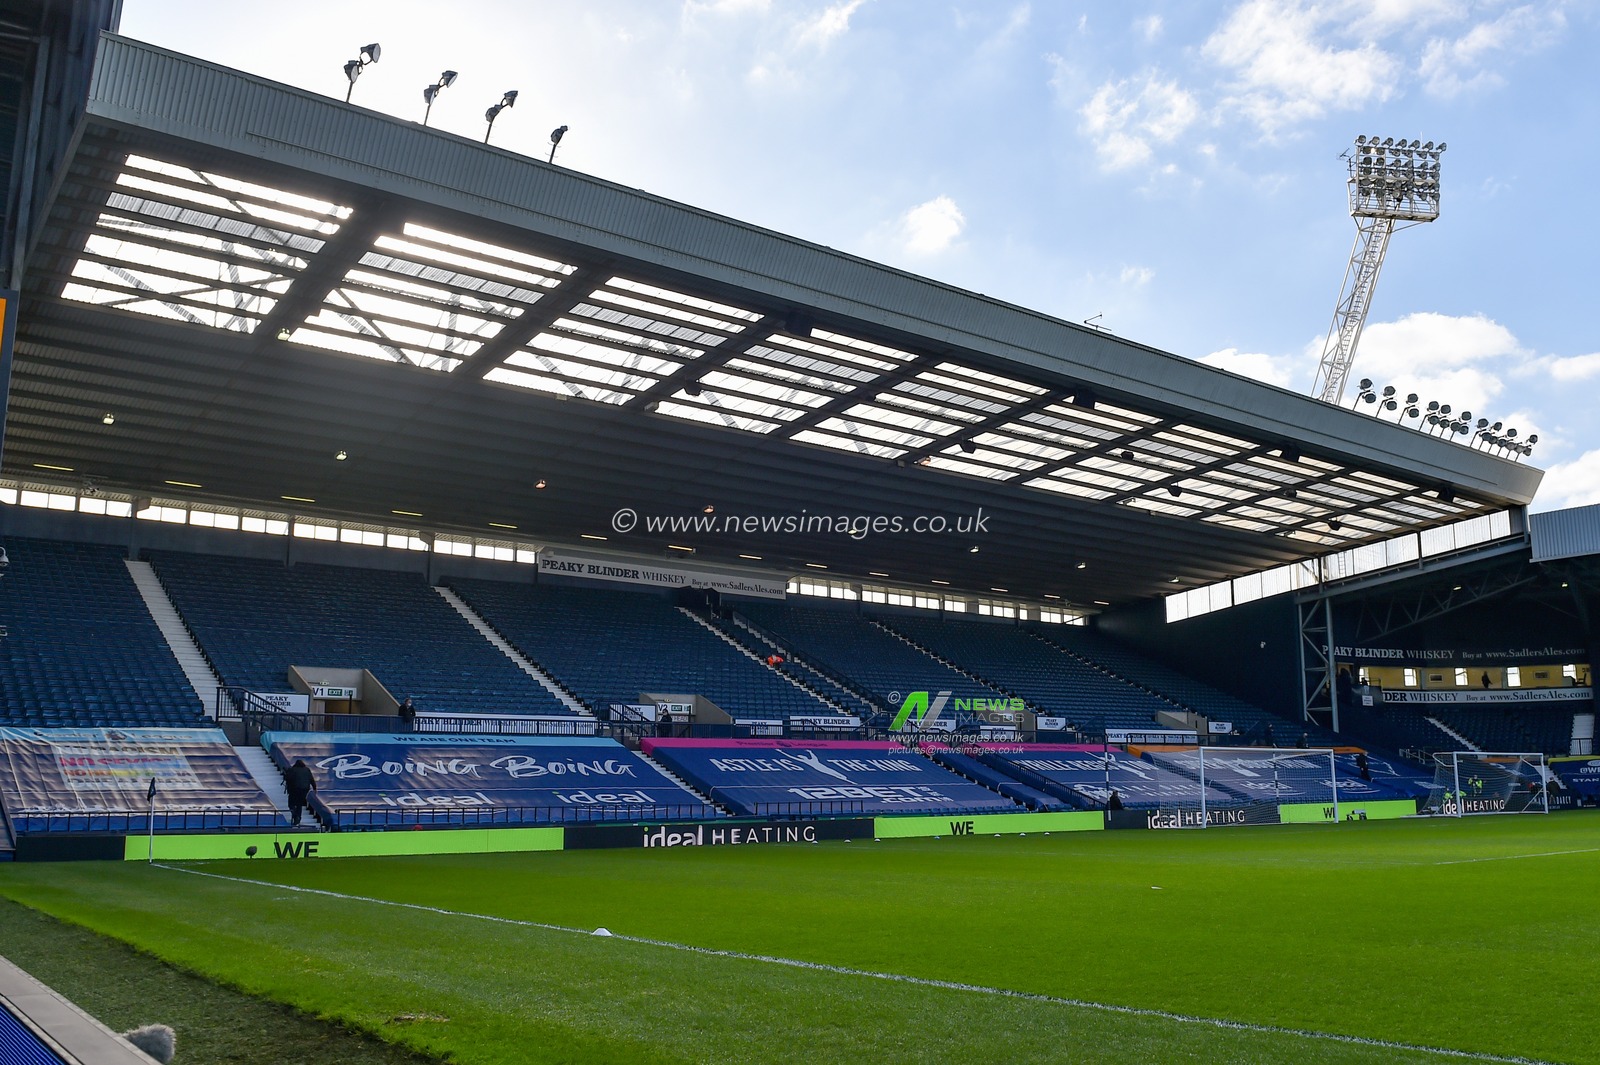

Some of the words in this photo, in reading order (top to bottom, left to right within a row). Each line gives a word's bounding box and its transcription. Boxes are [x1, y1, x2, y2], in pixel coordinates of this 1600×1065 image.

[541, 559, 585, 573] PEAKY
[587, 564, 640, 579] BLINDER
[642, 571, 687, 584] WHISKEY
[711, 580, 784, 596] www.SadlersAles.com
[1322, 644, 1353, 656] PAKY
[1354, 647, 1405, 659] BLINDER
[1406, 649, 1455, 659] WHISKEY
[1462, 651, 1474, 660] Buy
[1485, 647, 1585, 659] www.SadlersAles.com
[313, 687, 324, 696] V1
[1409, 692, 1459, 702] WHISKEY
[1466, 694, 1478, 702] Buy
[1489, 690, 1590, 701] www.SadlersAles.com
[59, 756, 95, 767] NO
[709, 758, 783, 772] ASTLE
[772, 759, 804, 772] IS
[827, 759, 878, 772] THE
[873, 759, 923, 772] KING
[378, 792, 495, 807] ideal
[552, 790, 656, 804] ideal
[787, 786, 925, 800] 12BET
[1442, 799, 1465, 815] idel
[1466, 799, 1506, 812] HEATING
[1147, 809, 1182, 830] ideal
[1185, 810, 1246, 825] HEATING
[950, 821, 975, 836] WE
[643, 825, 704, 848] ideal
[711, 825, 816, 846] HEATING
[274, 840, 320, 859] WE
